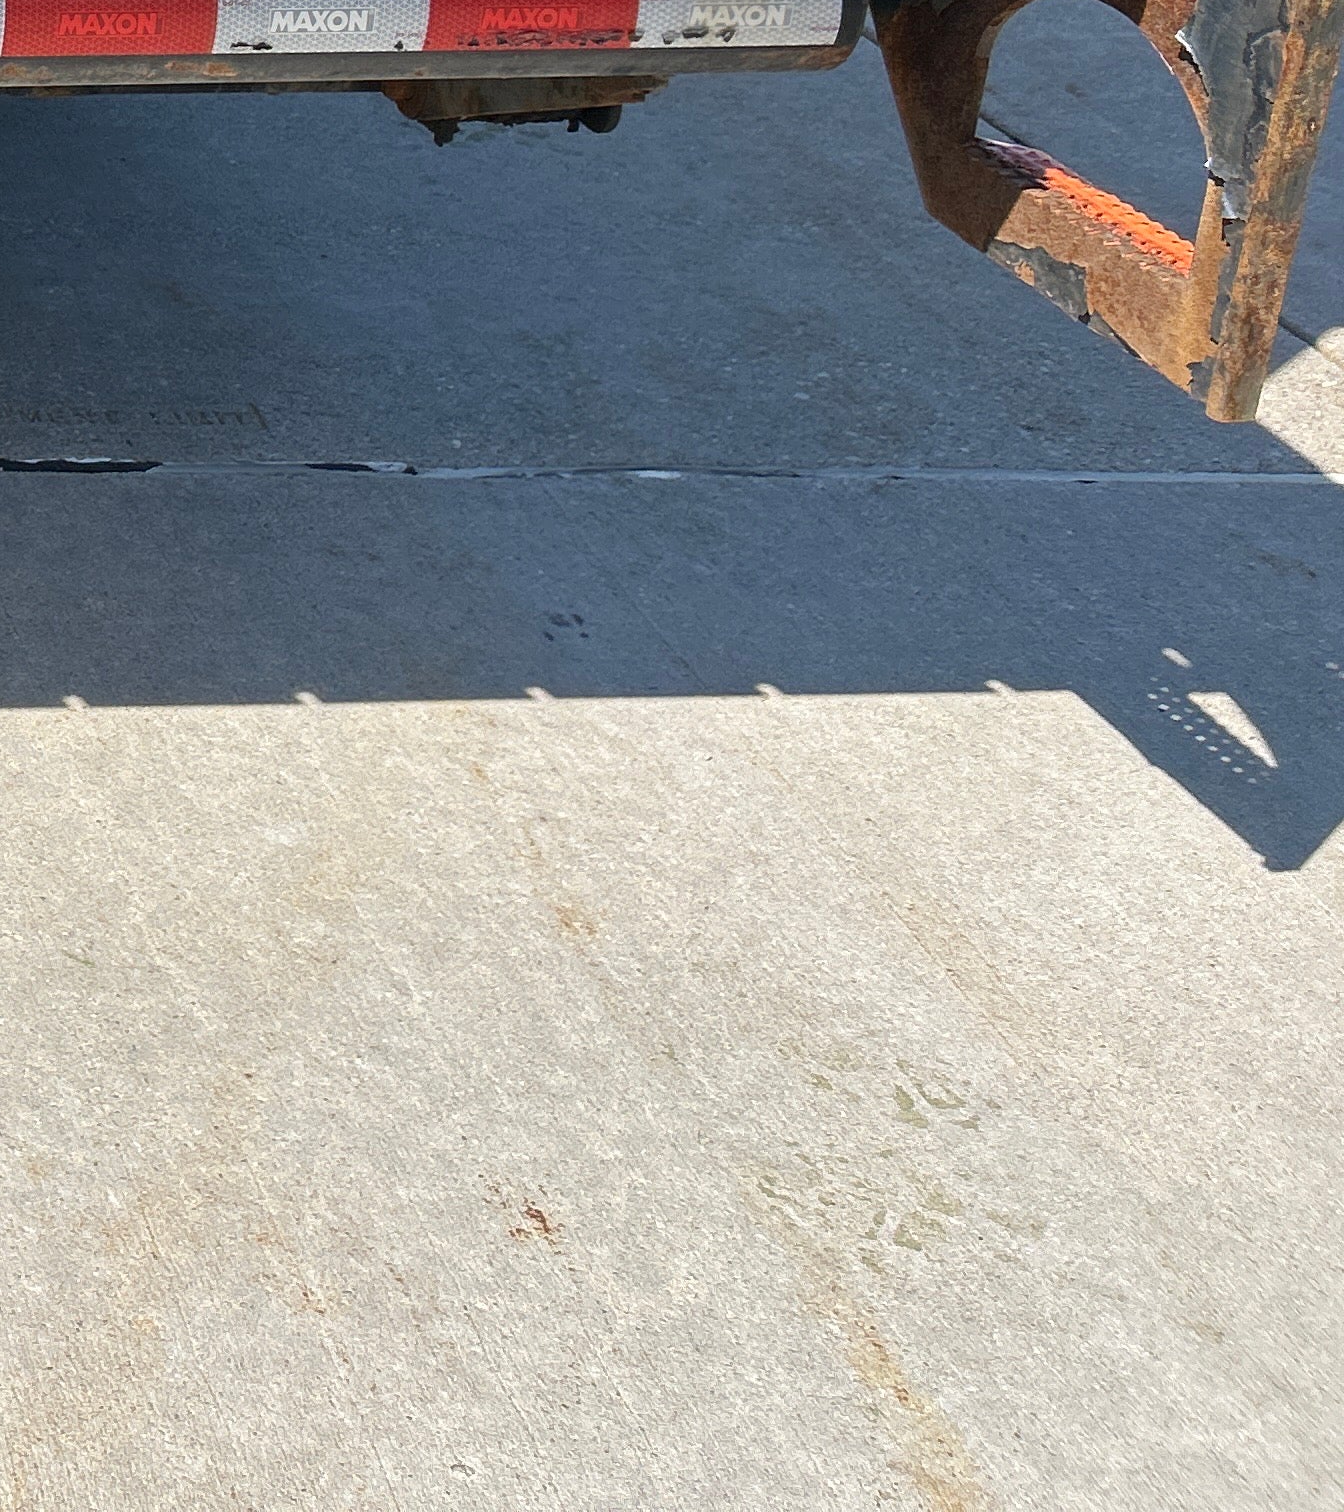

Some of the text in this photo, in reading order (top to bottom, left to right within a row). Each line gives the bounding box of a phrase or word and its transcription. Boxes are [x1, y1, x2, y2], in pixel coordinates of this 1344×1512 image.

[57, 12, 159, 36] MAXON
[269, 9, 370, 33] MAXON
[480, 6, 579, 30] MAXON
[689, 4, 787, 27] MAXON
